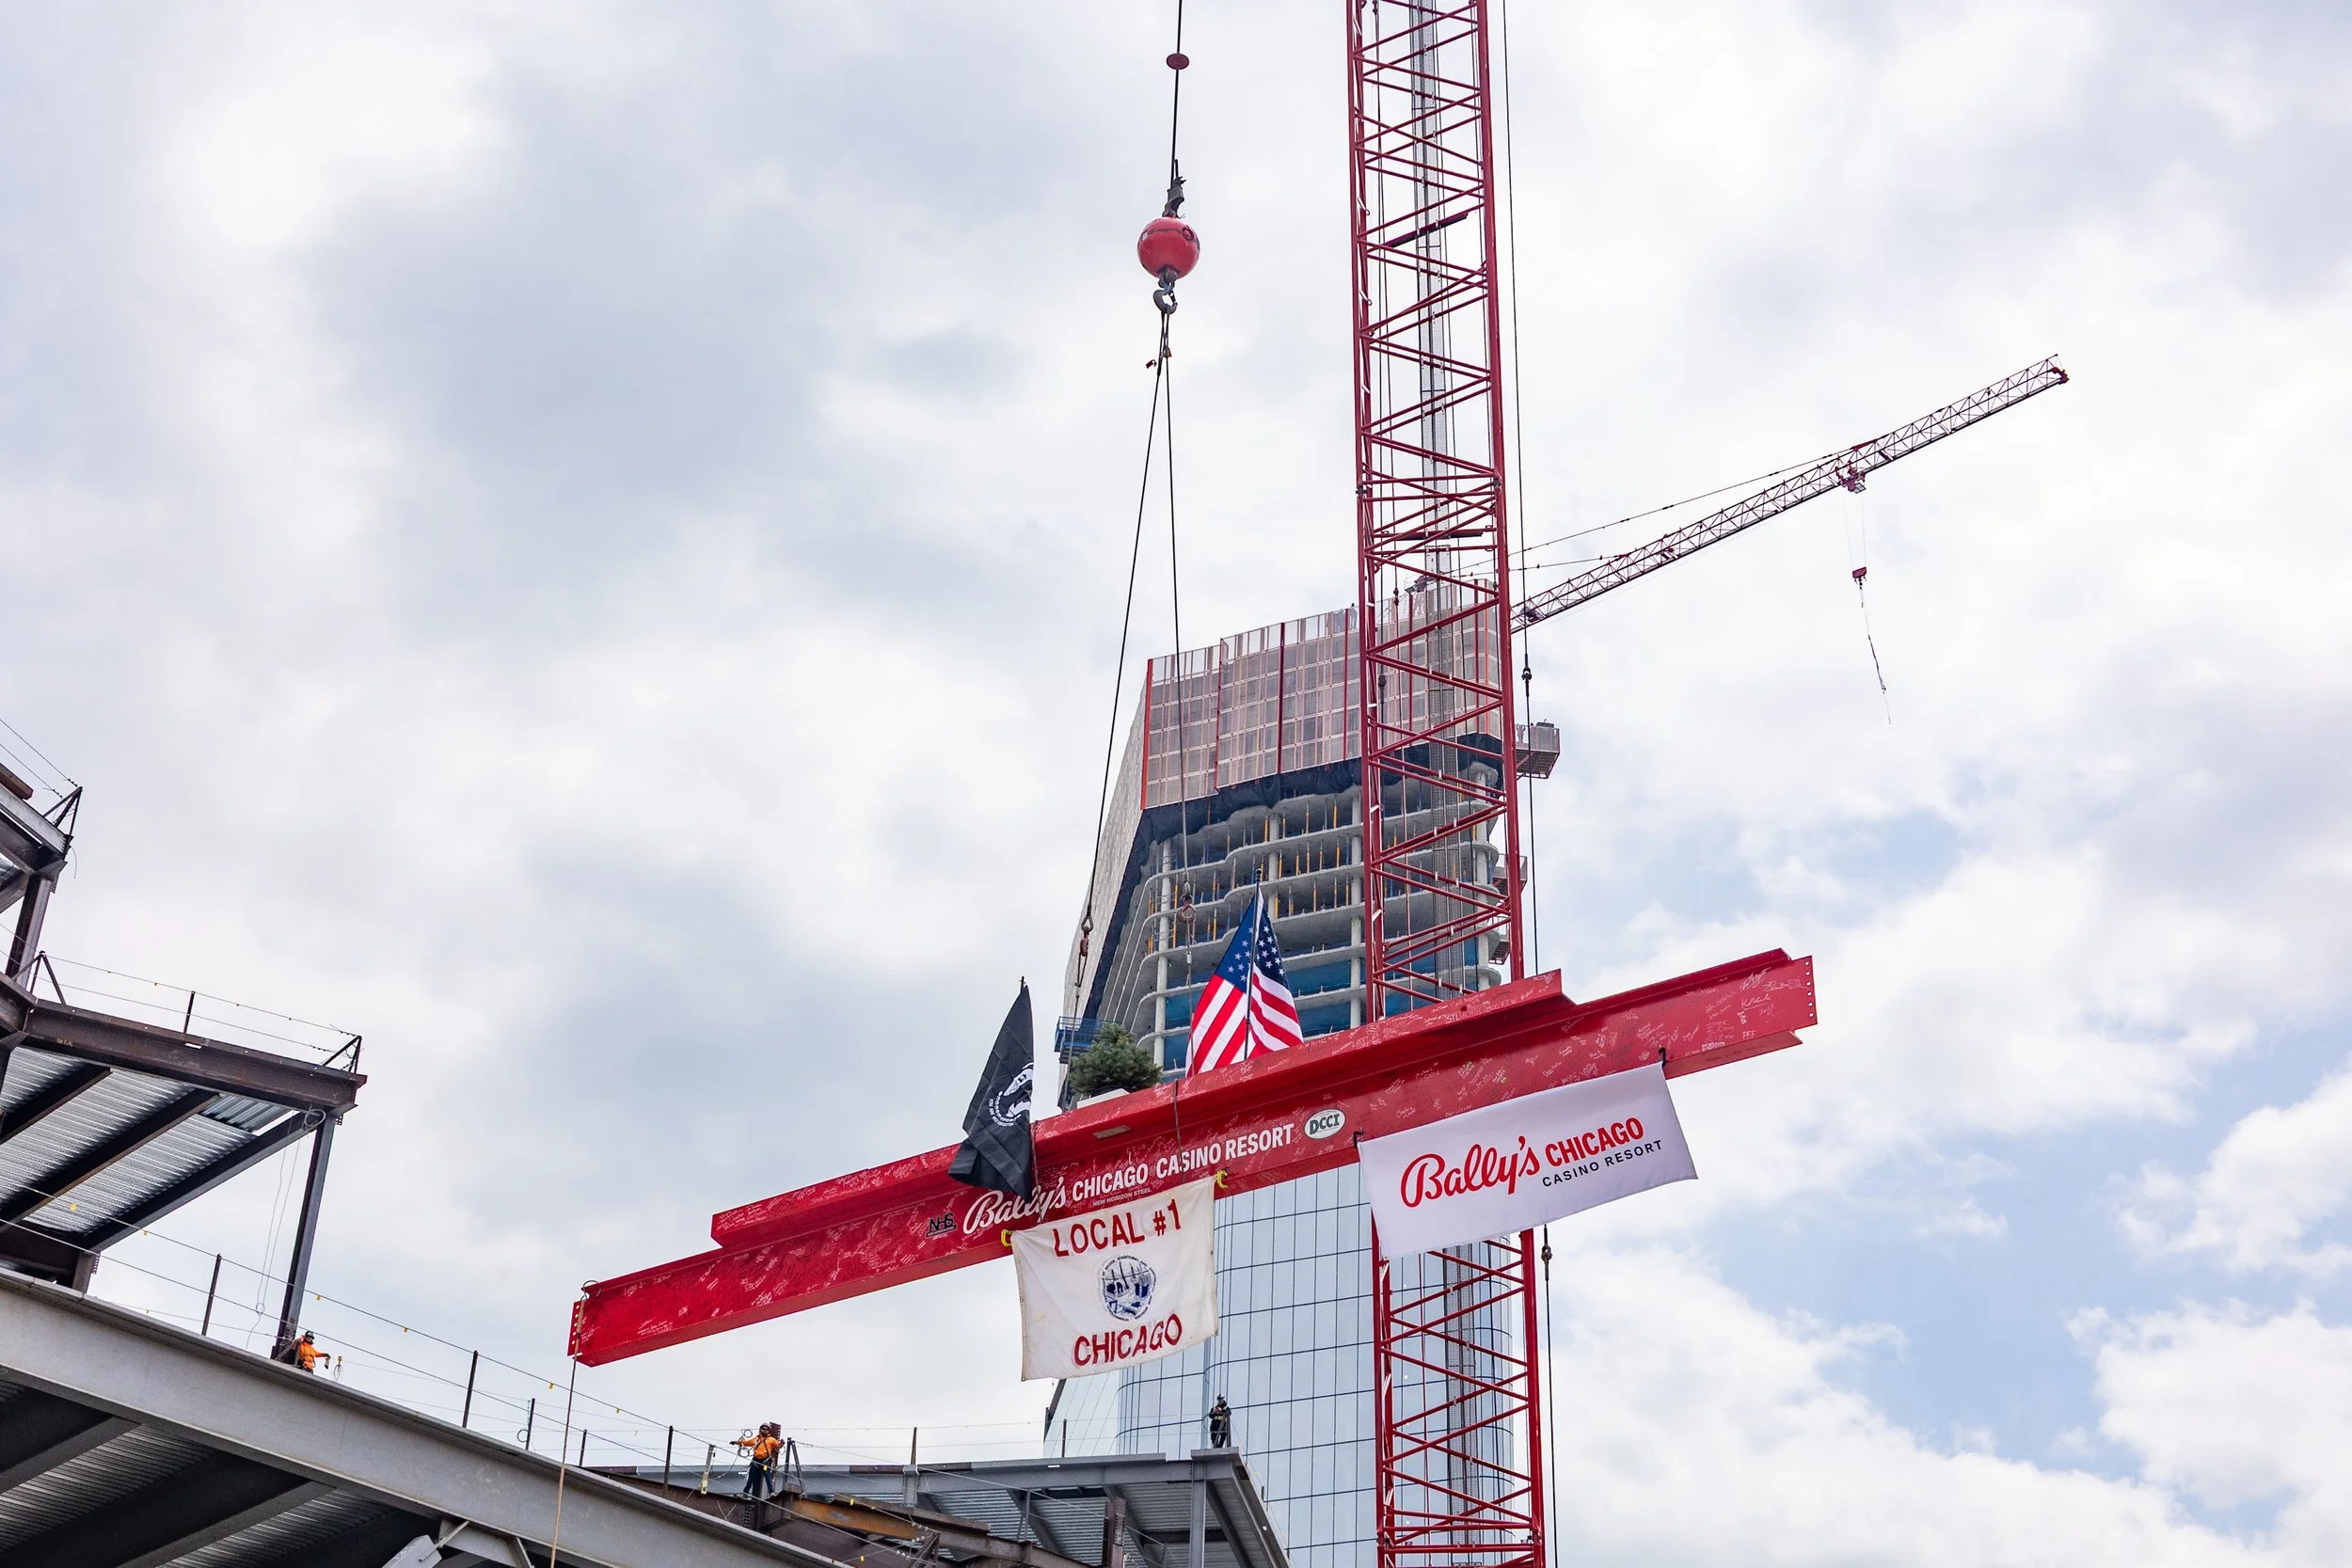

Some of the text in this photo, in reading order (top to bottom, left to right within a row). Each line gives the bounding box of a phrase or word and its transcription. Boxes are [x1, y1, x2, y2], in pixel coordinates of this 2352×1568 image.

[1310, 1114, 1340, 1134] DCCI
[963, 1123, 1295, 1235] Bally's CHICAGO CASINO RESORT
[1401, 1117, 1644, 1208] Bally's CHICAGO
[1542, 1139, 1662, 1187] CASINO RESORT
[930, 1212, 954, 1232] NHS
[1092, 1187, 1152, 1207] NEW HORIZON STEEL
[1054, 1198, 1183, 1257] LOCAL #1
[1073, 1313, 1183, 1367] CHICAGO
